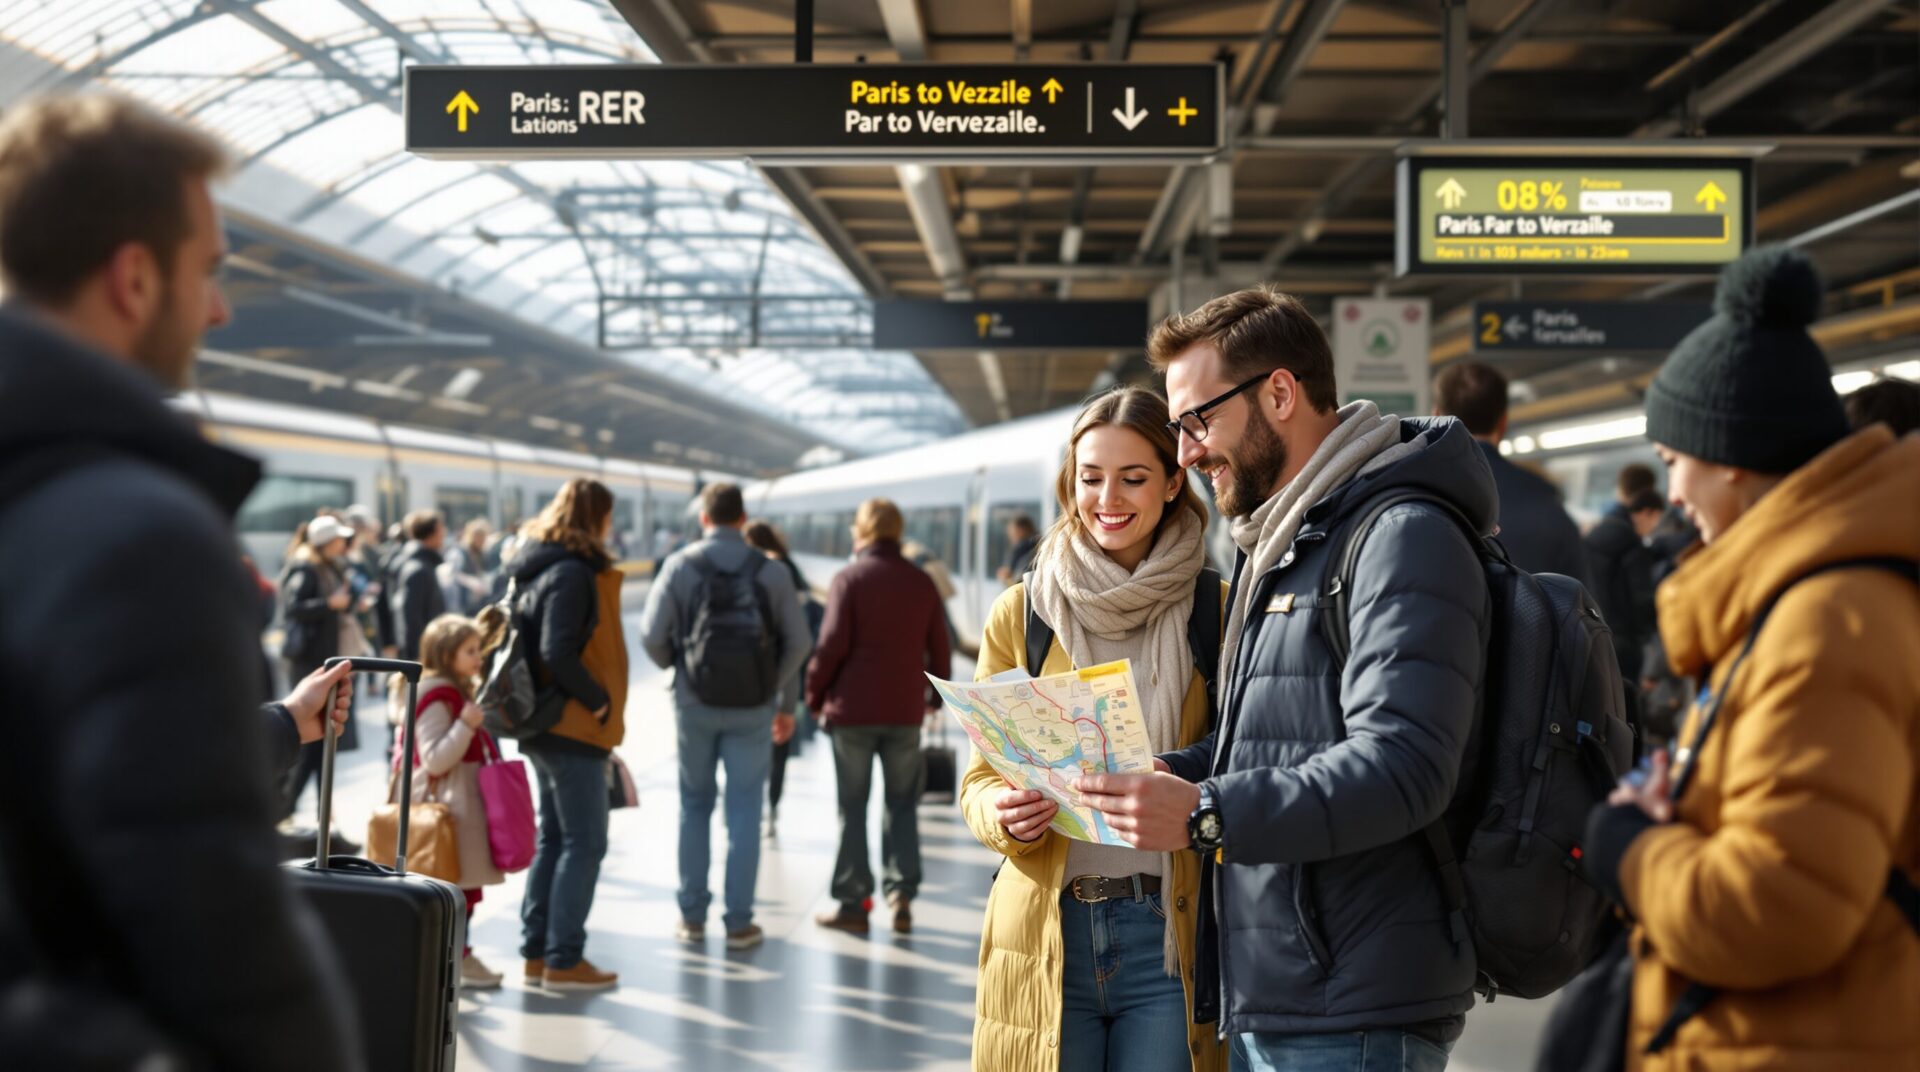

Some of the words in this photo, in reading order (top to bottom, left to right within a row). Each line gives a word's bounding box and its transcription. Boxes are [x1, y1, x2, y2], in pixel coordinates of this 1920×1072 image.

[851, 80, 911, 104] Paris
[917, 82, 943, 104] to
[947, 80, 1032, 104] Vezzile
[579, 91, 646, 124] RER
[511, 115, 578, 134] Lations
[845, 110, 883, 133] Par
[887, 112, 913, 133] to
[916, 110, 1046, 133] Vervezaile.
[1497, 180, 1568, 211] 08%
[1438, 214, 1482, 234] Paris
[1516, 216, 1538, 234] to
[1481, 313, 1500, 343] 2
